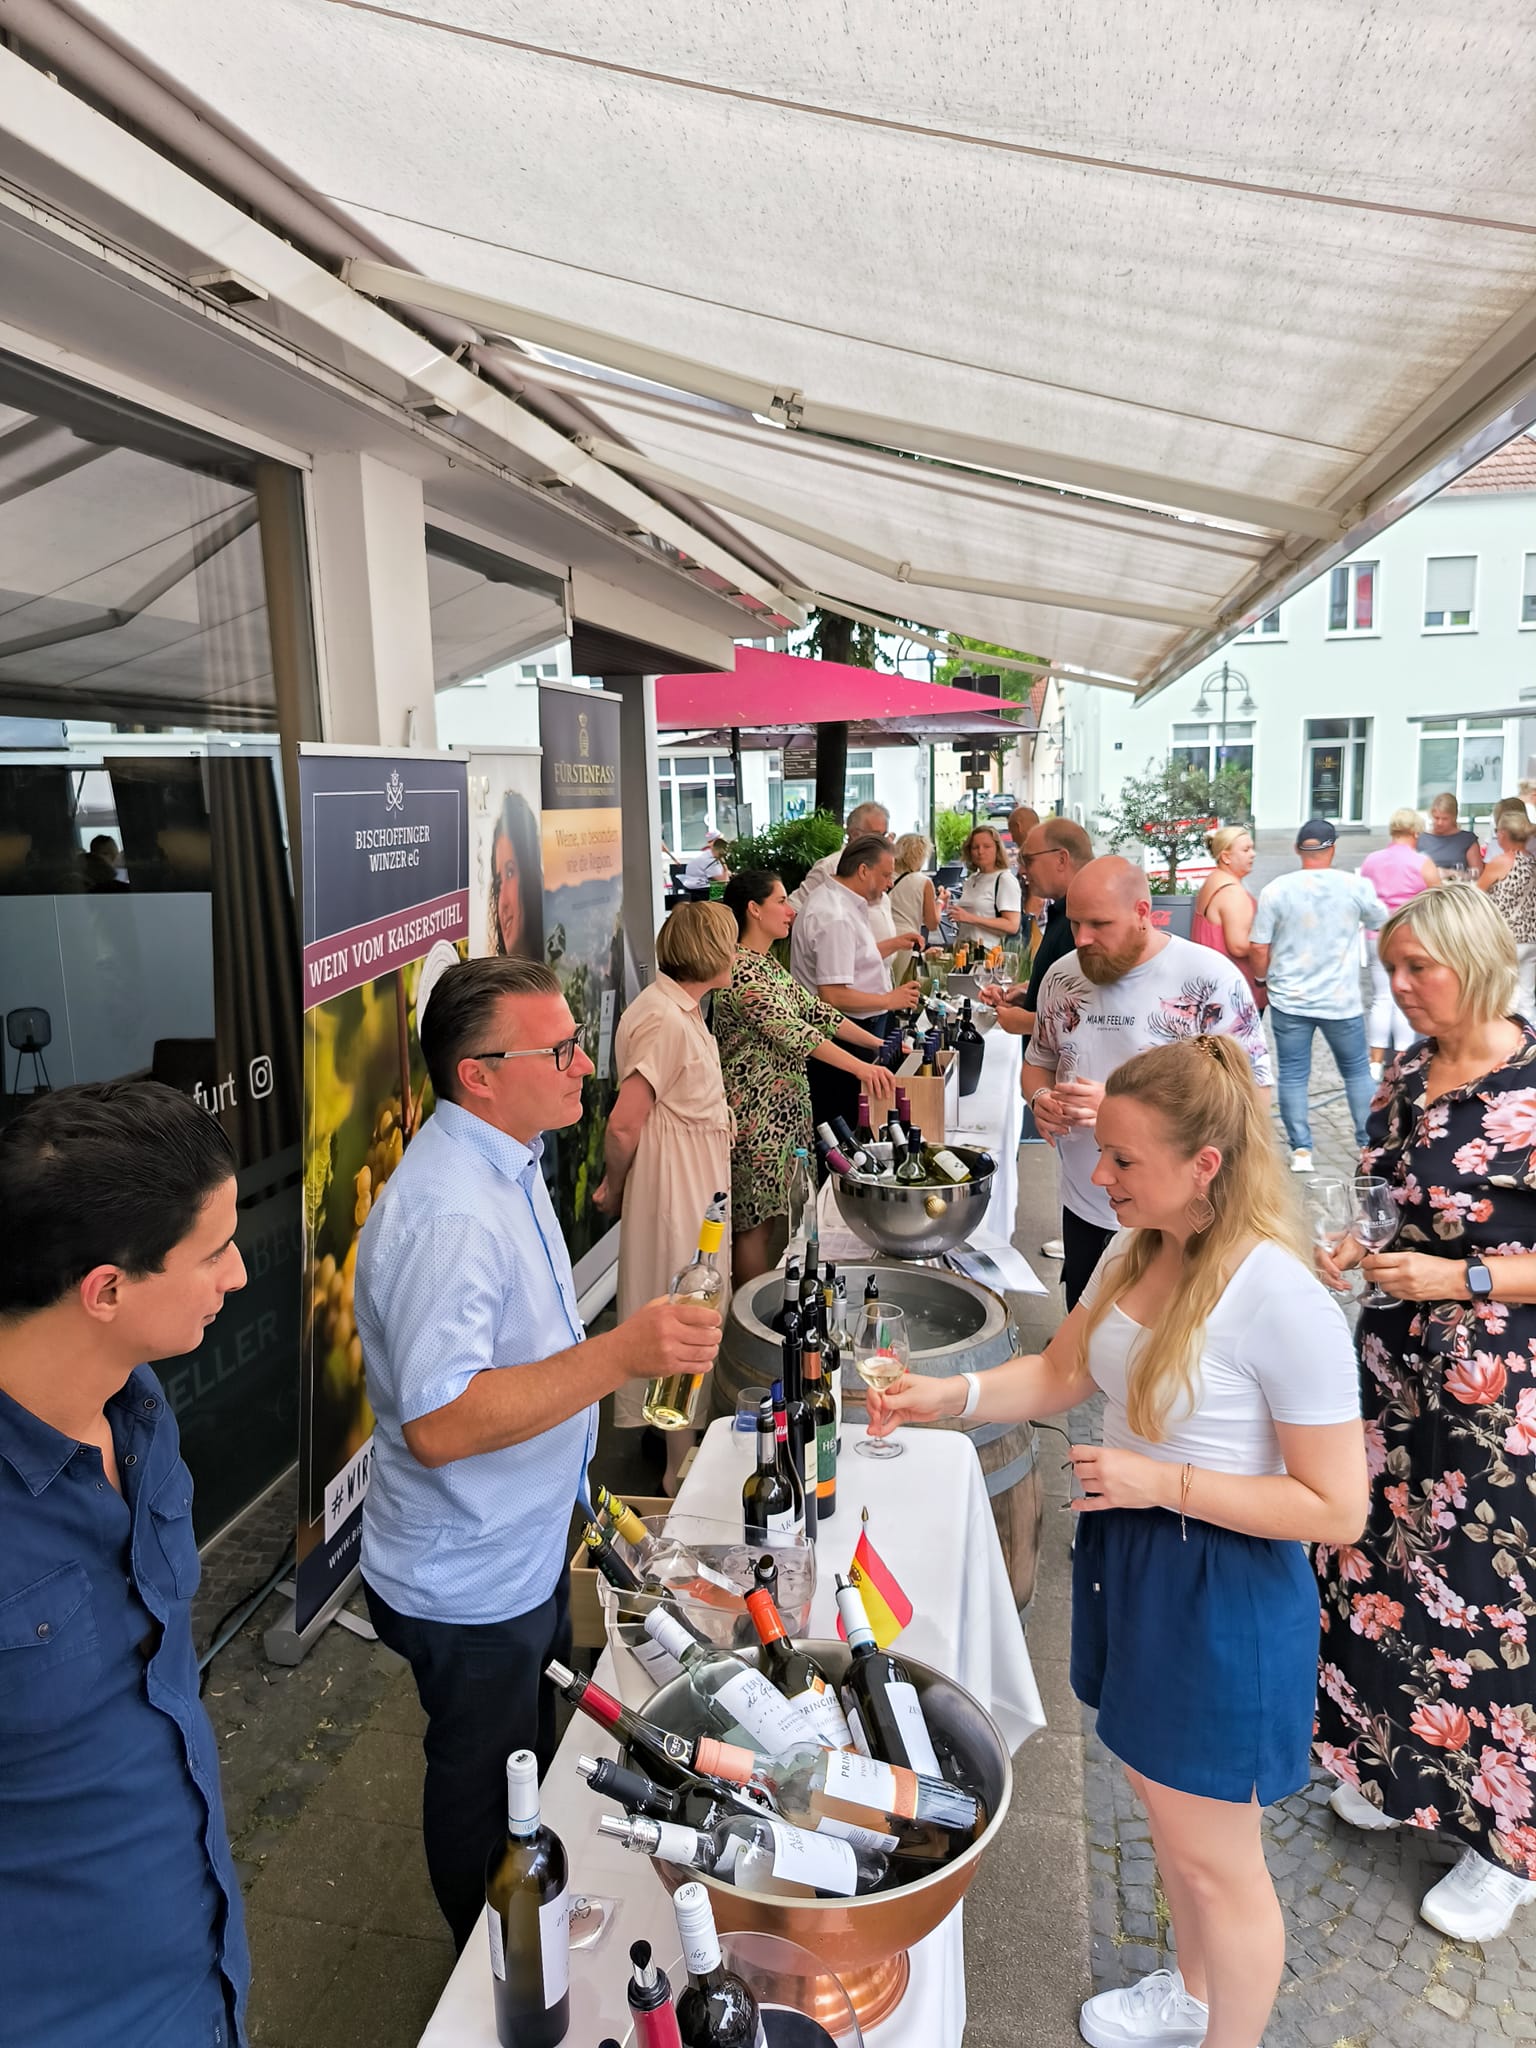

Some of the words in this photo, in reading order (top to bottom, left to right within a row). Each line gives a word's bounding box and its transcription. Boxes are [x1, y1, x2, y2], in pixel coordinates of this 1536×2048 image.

[553, 760, 616, 784] FÜRSTENFASS
[355, 825, 431, 850] BISCHOFFINGER
[368, 850, 407, 873] WINZER
[408, 849, 420, 867] eG
[308, 948, 349, 988] WEIN
[352, 933, 384, 968] VOM
[387, 902, 463, 953] KAISERSTUHL
[1085, 1014, 1105, 1025] MIAMI
[1106, 1015, 1135, 1026] FEELING
[166, 1309, 280, 1416] ELLER
